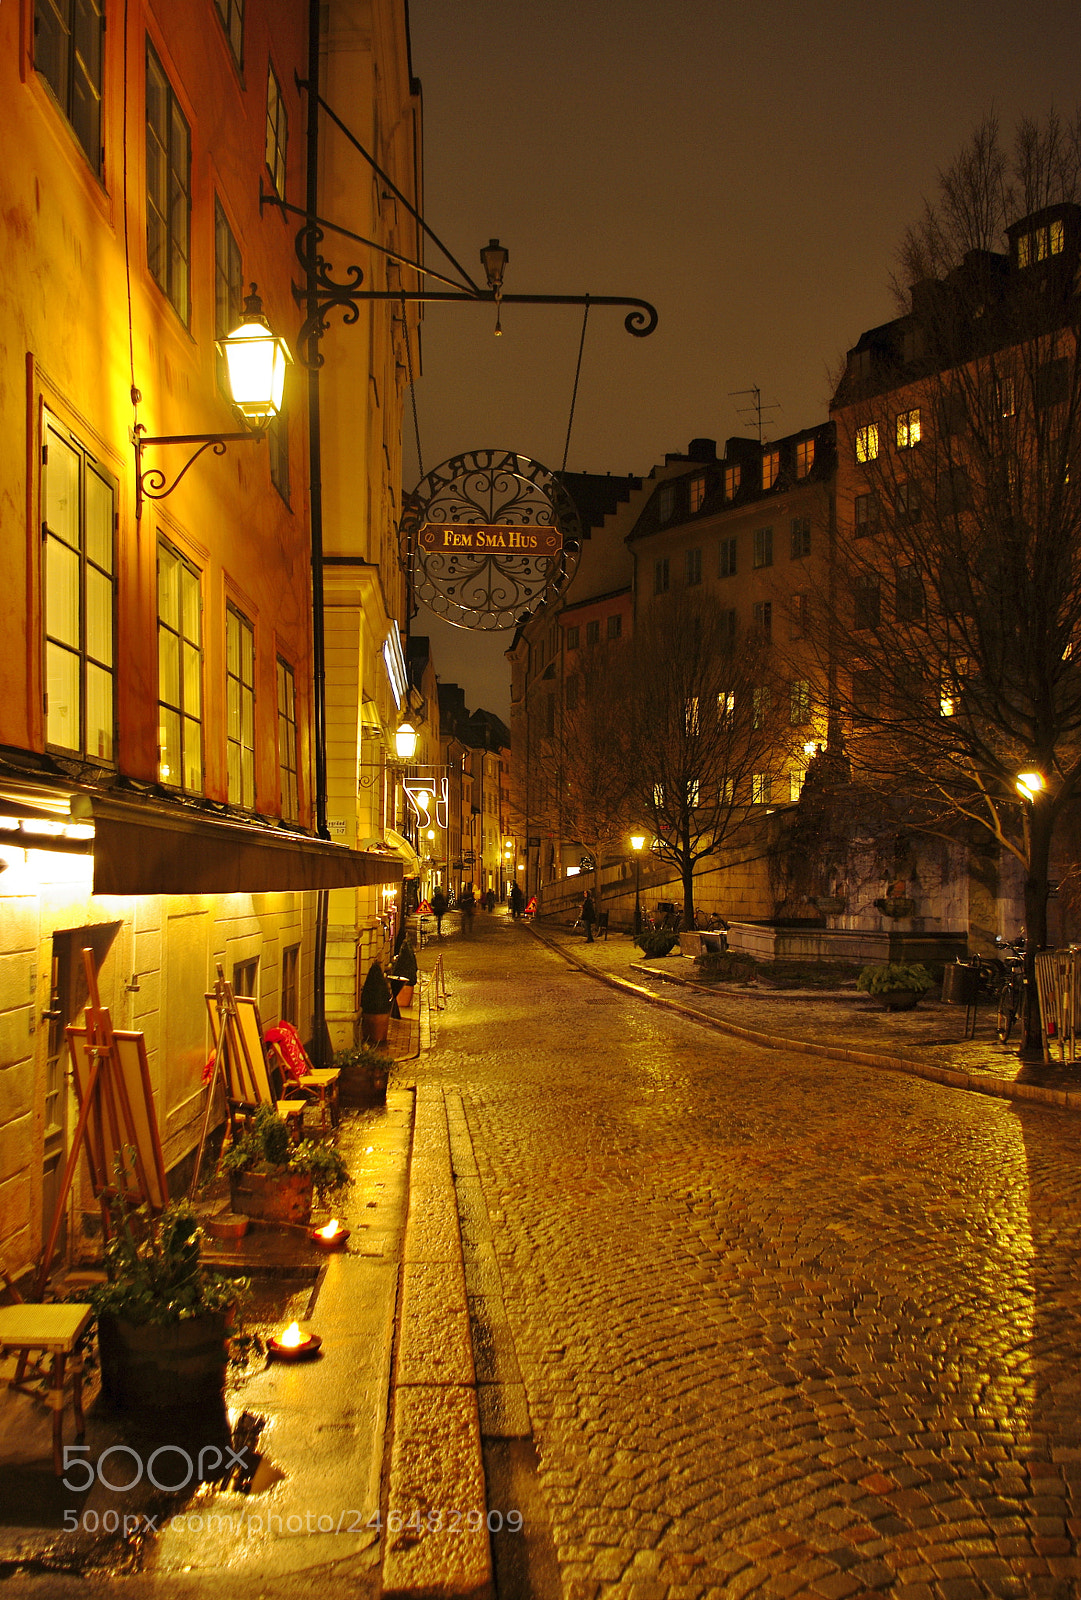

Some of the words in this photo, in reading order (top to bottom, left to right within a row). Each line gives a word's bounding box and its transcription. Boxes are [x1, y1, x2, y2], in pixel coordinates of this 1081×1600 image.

[443, 530, 473, 546] FEM
[476, 531, 506, 547] SMÅ
[508, 532, 538, 548] HUS
